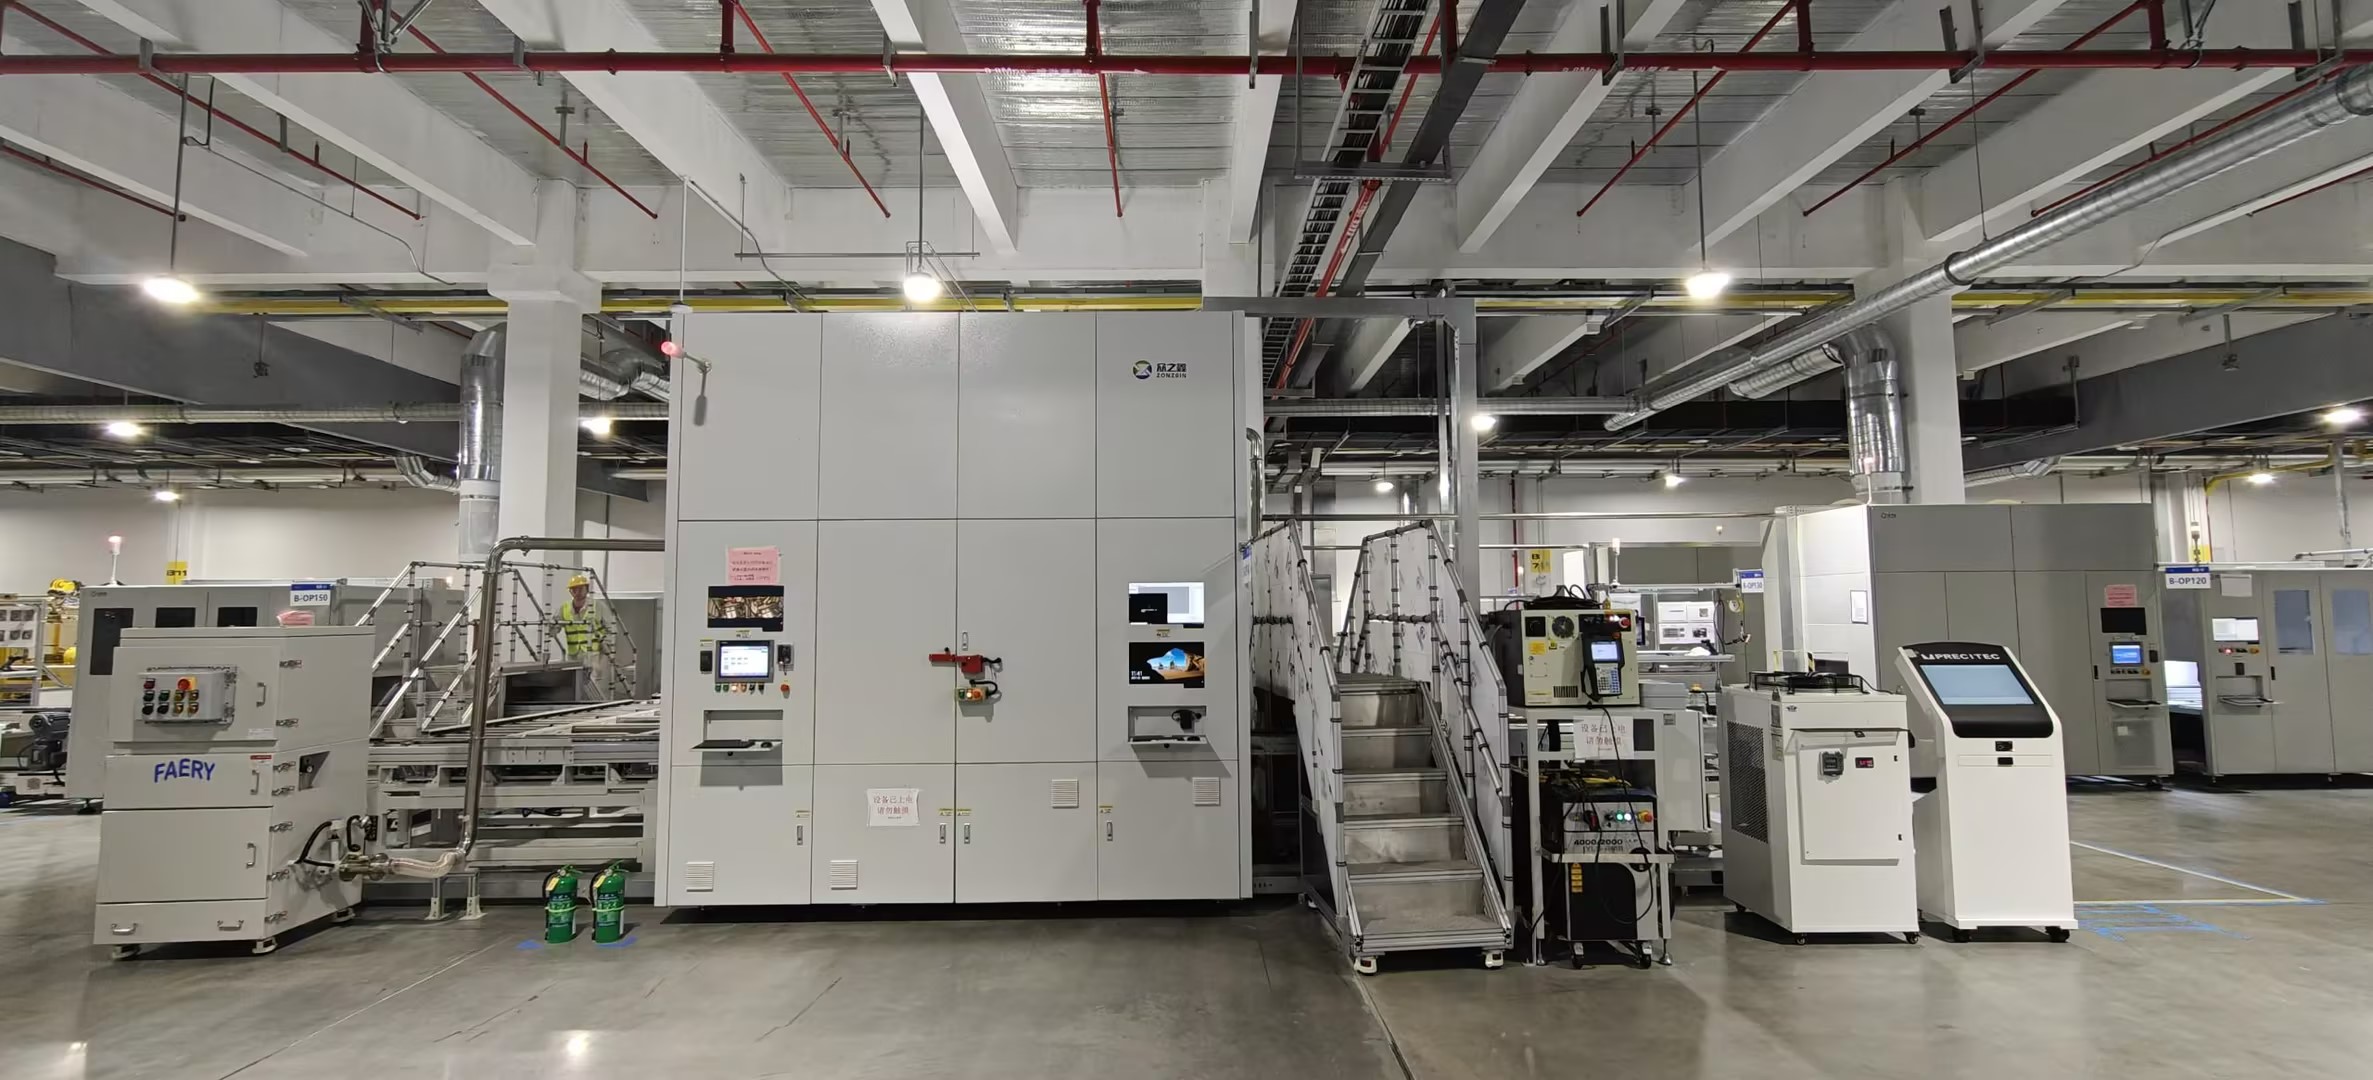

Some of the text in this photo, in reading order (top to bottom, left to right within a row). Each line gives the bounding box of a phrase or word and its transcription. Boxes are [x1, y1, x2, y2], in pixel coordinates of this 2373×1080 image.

[2169, 577, 2207, 585] B-OP120
[294, 594, 328, 602] B-OP150
[154, 758, 215, 782] FAERY
